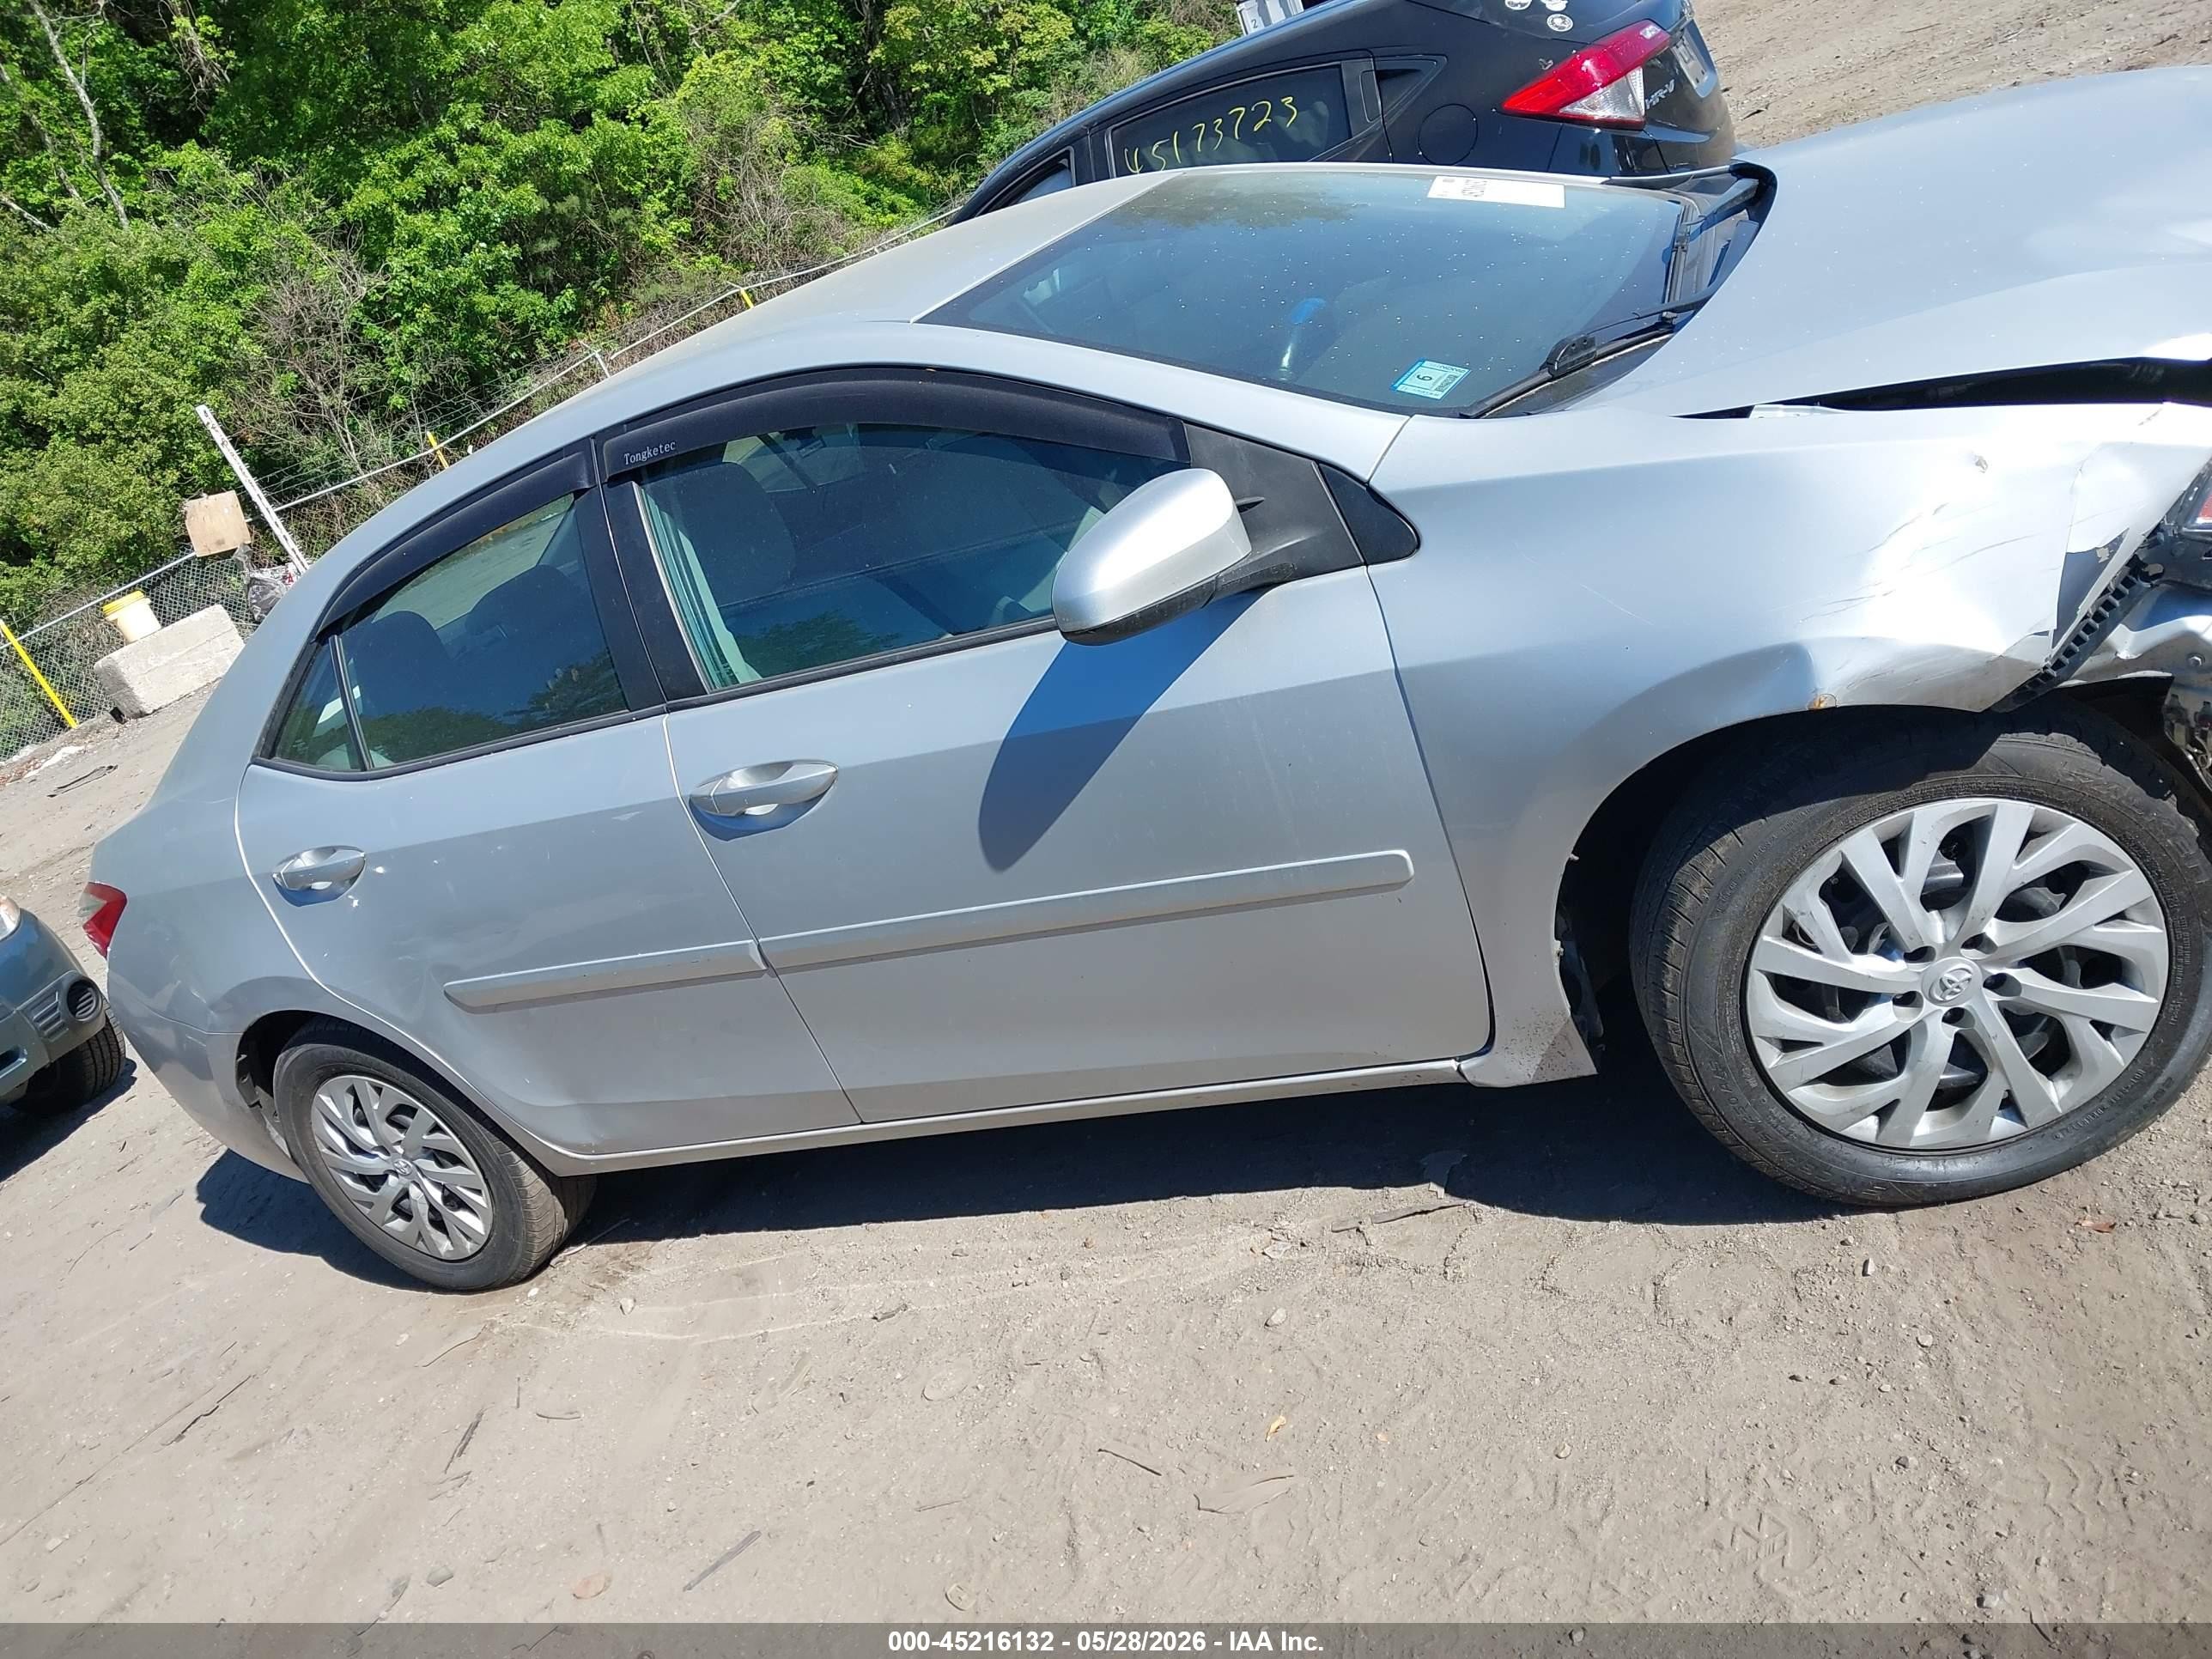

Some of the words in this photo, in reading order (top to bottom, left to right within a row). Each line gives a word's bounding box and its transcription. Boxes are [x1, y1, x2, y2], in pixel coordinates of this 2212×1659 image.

[1644, 78, 1675, 110] HR-V
[1124, 96, 1298, 175] 45173723
[623, 441, 676, 465] Tongketec
